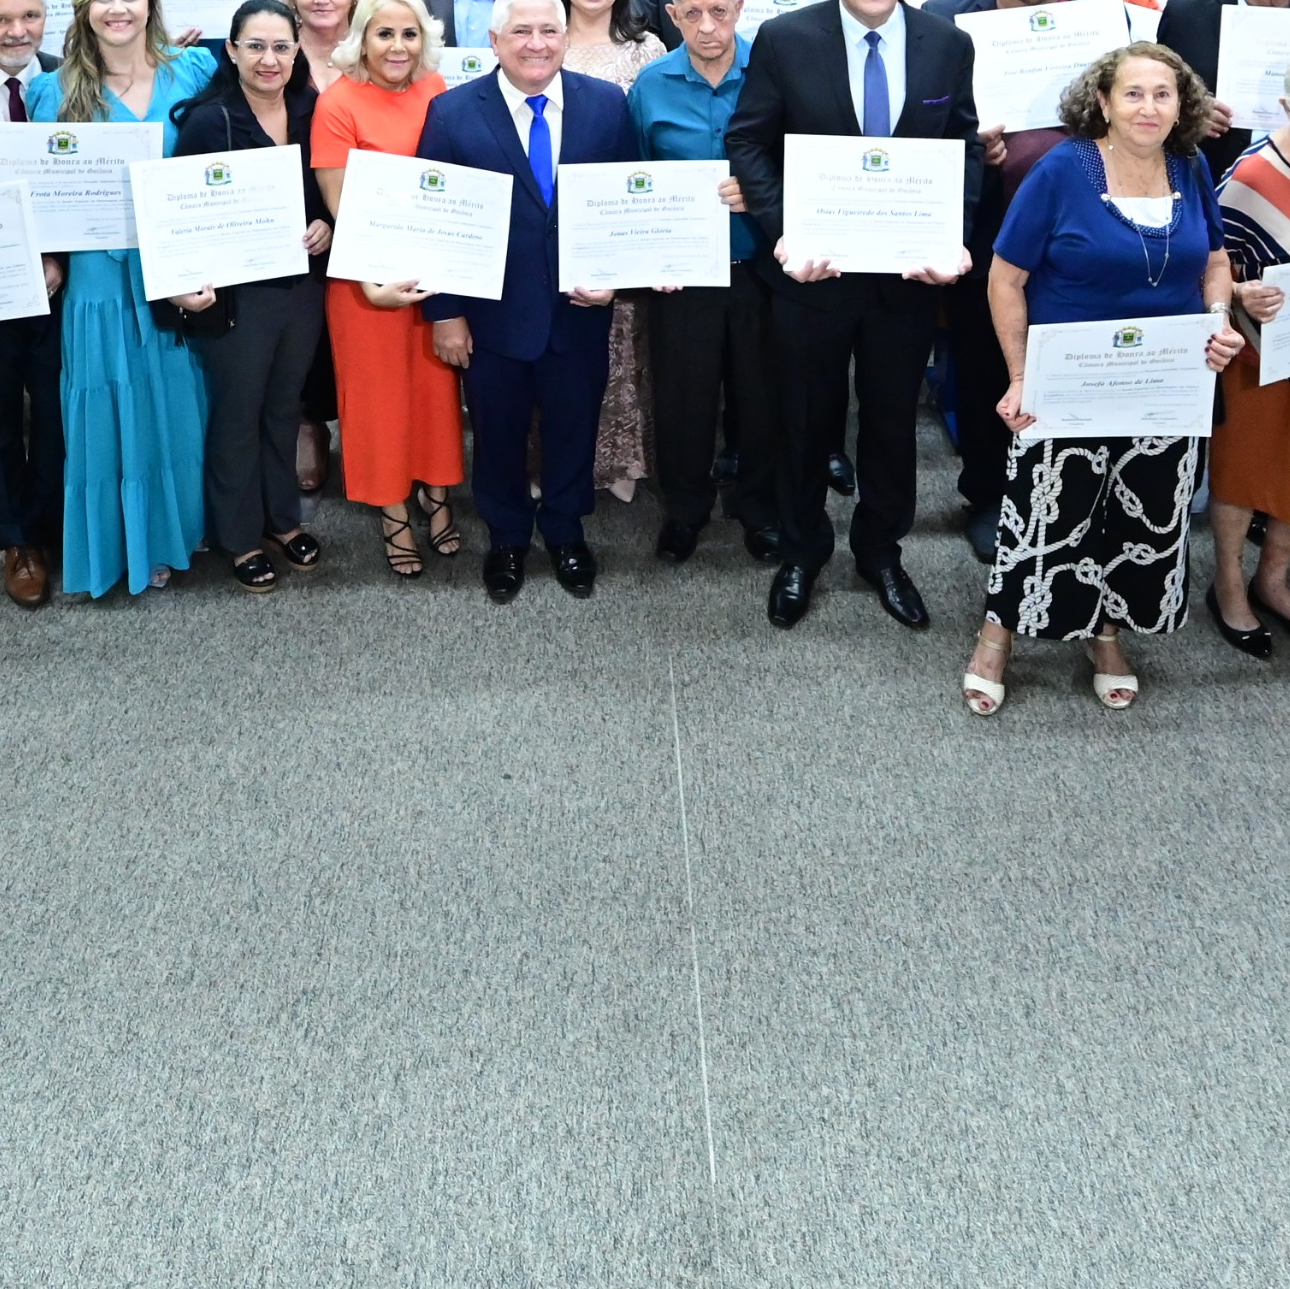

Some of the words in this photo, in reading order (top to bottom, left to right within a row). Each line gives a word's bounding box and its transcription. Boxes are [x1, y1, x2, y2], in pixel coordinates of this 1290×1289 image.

[40, 158, 49, 166] de
[53, 157, 80, 166] Honra
[95, 156, 125, 166] Mérito
[85, 189, 121, 197] Rodrigues
[586, 199, 619, 208] Diploma
[631, 196, 655, 204] Honra
[669, 195, 695, 203] Mérito
[1065, 352, 1101, 361] Diploma
[1117, 350, 1144, 359] Honra
[1158, 347, 1188, 356] Mérito
[1081, 380, 1105, 388] Josefa
